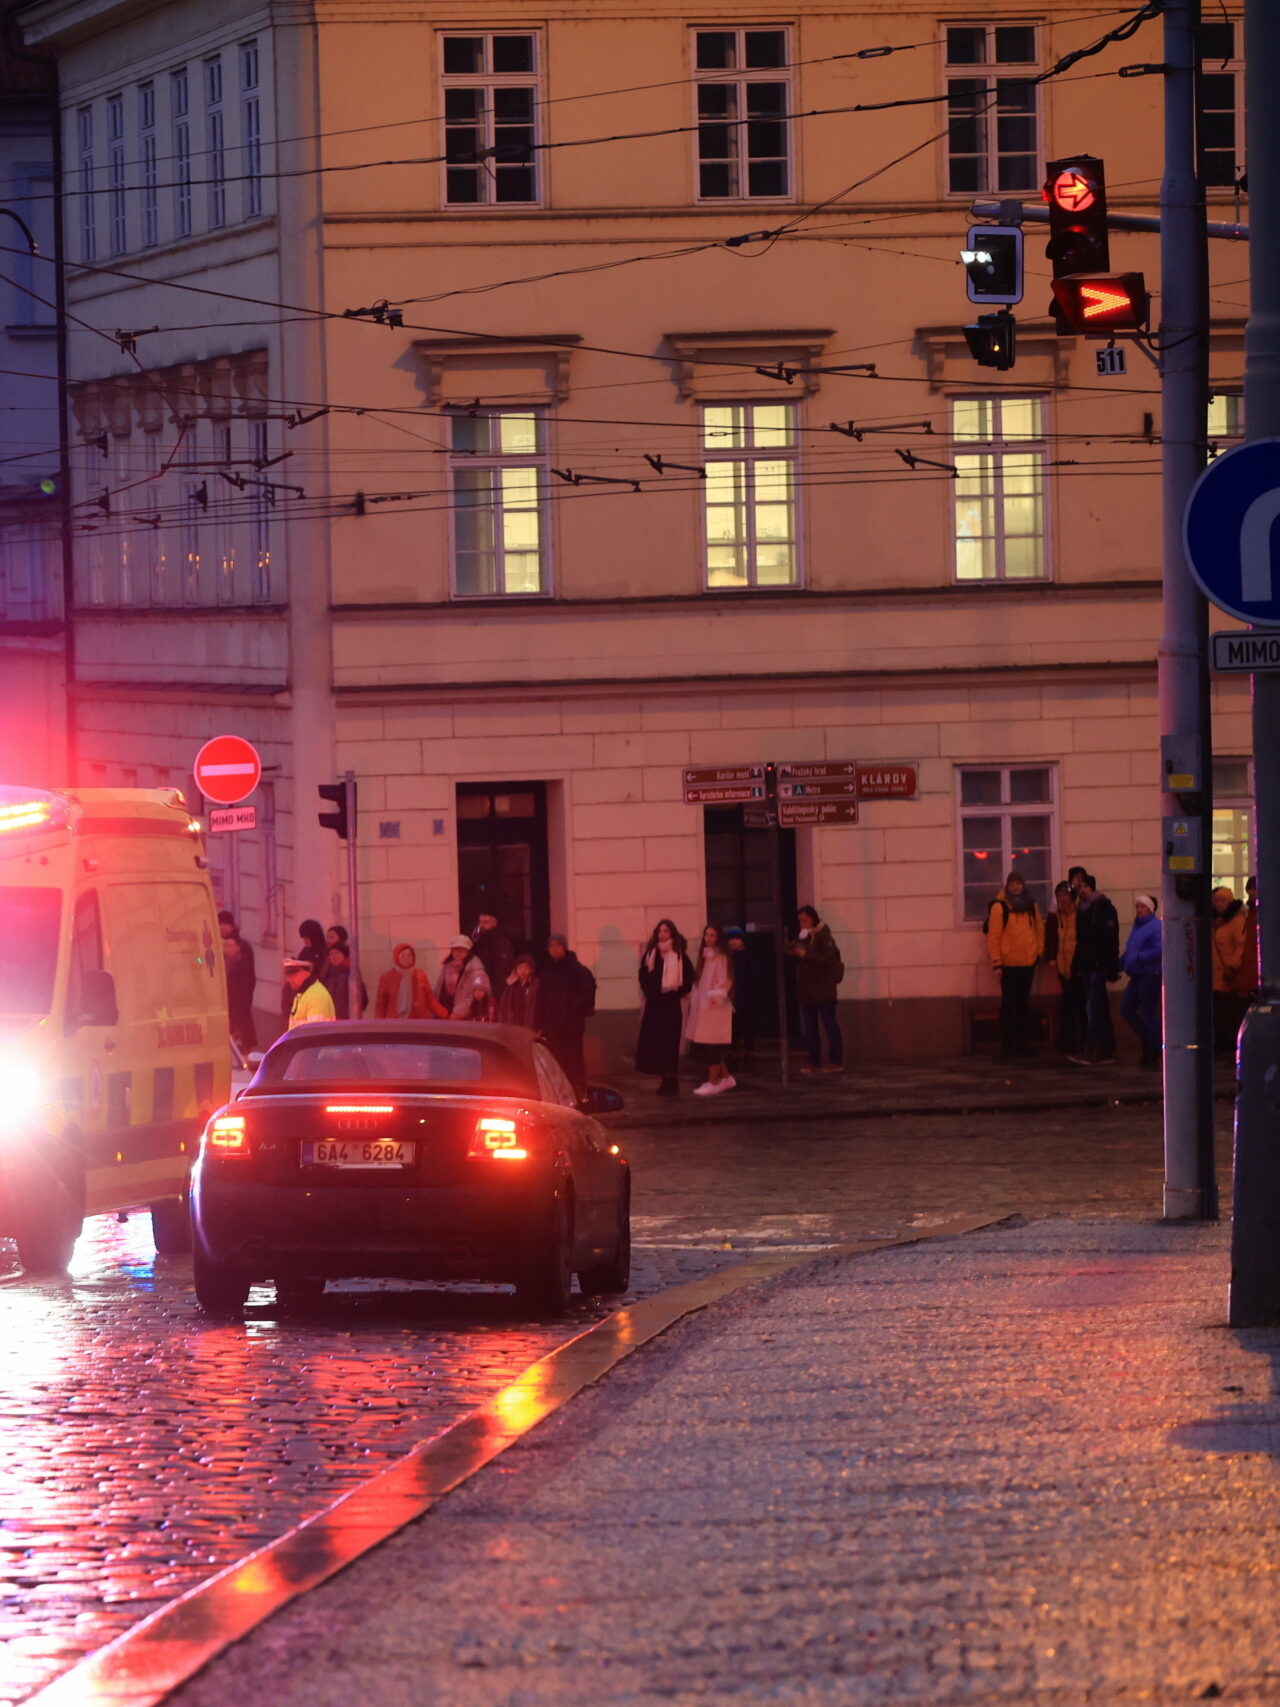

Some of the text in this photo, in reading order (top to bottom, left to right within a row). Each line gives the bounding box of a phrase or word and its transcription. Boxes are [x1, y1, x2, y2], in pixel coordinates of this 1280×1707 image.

[1096, 350, 1125, 377] 511
[1228, 640, 1280, 664] MIMO
[861, 771, 907, 785] KLÁROV
[211, 814, 234, 826] MIMO
[317, 1143, 405, 1161] 6A4 6284
